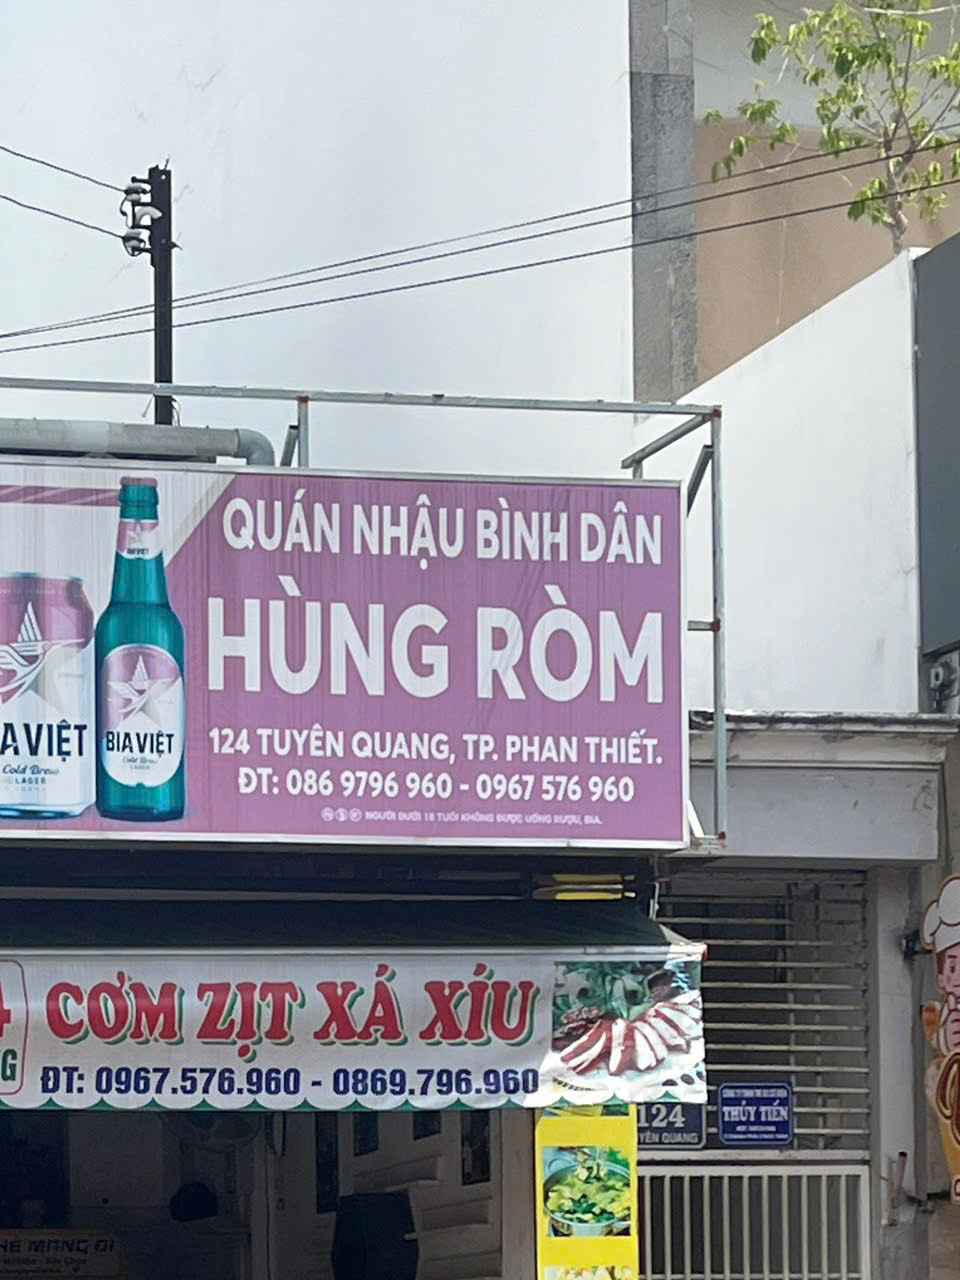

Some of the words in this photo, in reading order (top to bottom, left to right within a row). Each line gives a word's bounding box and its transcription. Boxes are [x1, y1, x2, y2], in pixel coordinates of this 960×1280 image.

[223, 489, 341, 553] QUÁN
[352, 493, 464, 571] NHẬU
[476, 496, 568, 561] BÌNH
[580, 500, 662, 565] DÂN
[208, 575, 449, 698] HÙNG
[476, 584, 664, 703] RÒM
[208, 728, 250, 755] 124
[257, 722, 344, 757] TUYÊN
[351, 732, 456, 765] QUANG,
[463, 733, 499, 761] TP.
[506, 735, 579, 763] PHAN
[584, 728, 663, 765] THIẾT.
[238, 766, 279, 795] ĐT:
[286, 769, 334, 796] 086
[340, 770, 399, 798] 9796
[406, 771, 453, 799] 960
[476, 774, 533, 801] 0967
[540, 775, 581, 802] 576
[588, 776, 635, 803] 960
[45, 970, 184, 1045] CƠM
[196, 980, 306, 1062] ZỊT
[418, 963, 540, 1046] XÍU
[40, 1065, 85, 1094] ĐT:
[95, 1066, 302, 1095] 0967.576.960
[333, 1067, 540, 1096] 0869.796.960
[638, 1103, 686, 1128] 124
[639, 1130, 659, 1143] YÊN
[661, 1131, 699, 1144] QUANG
